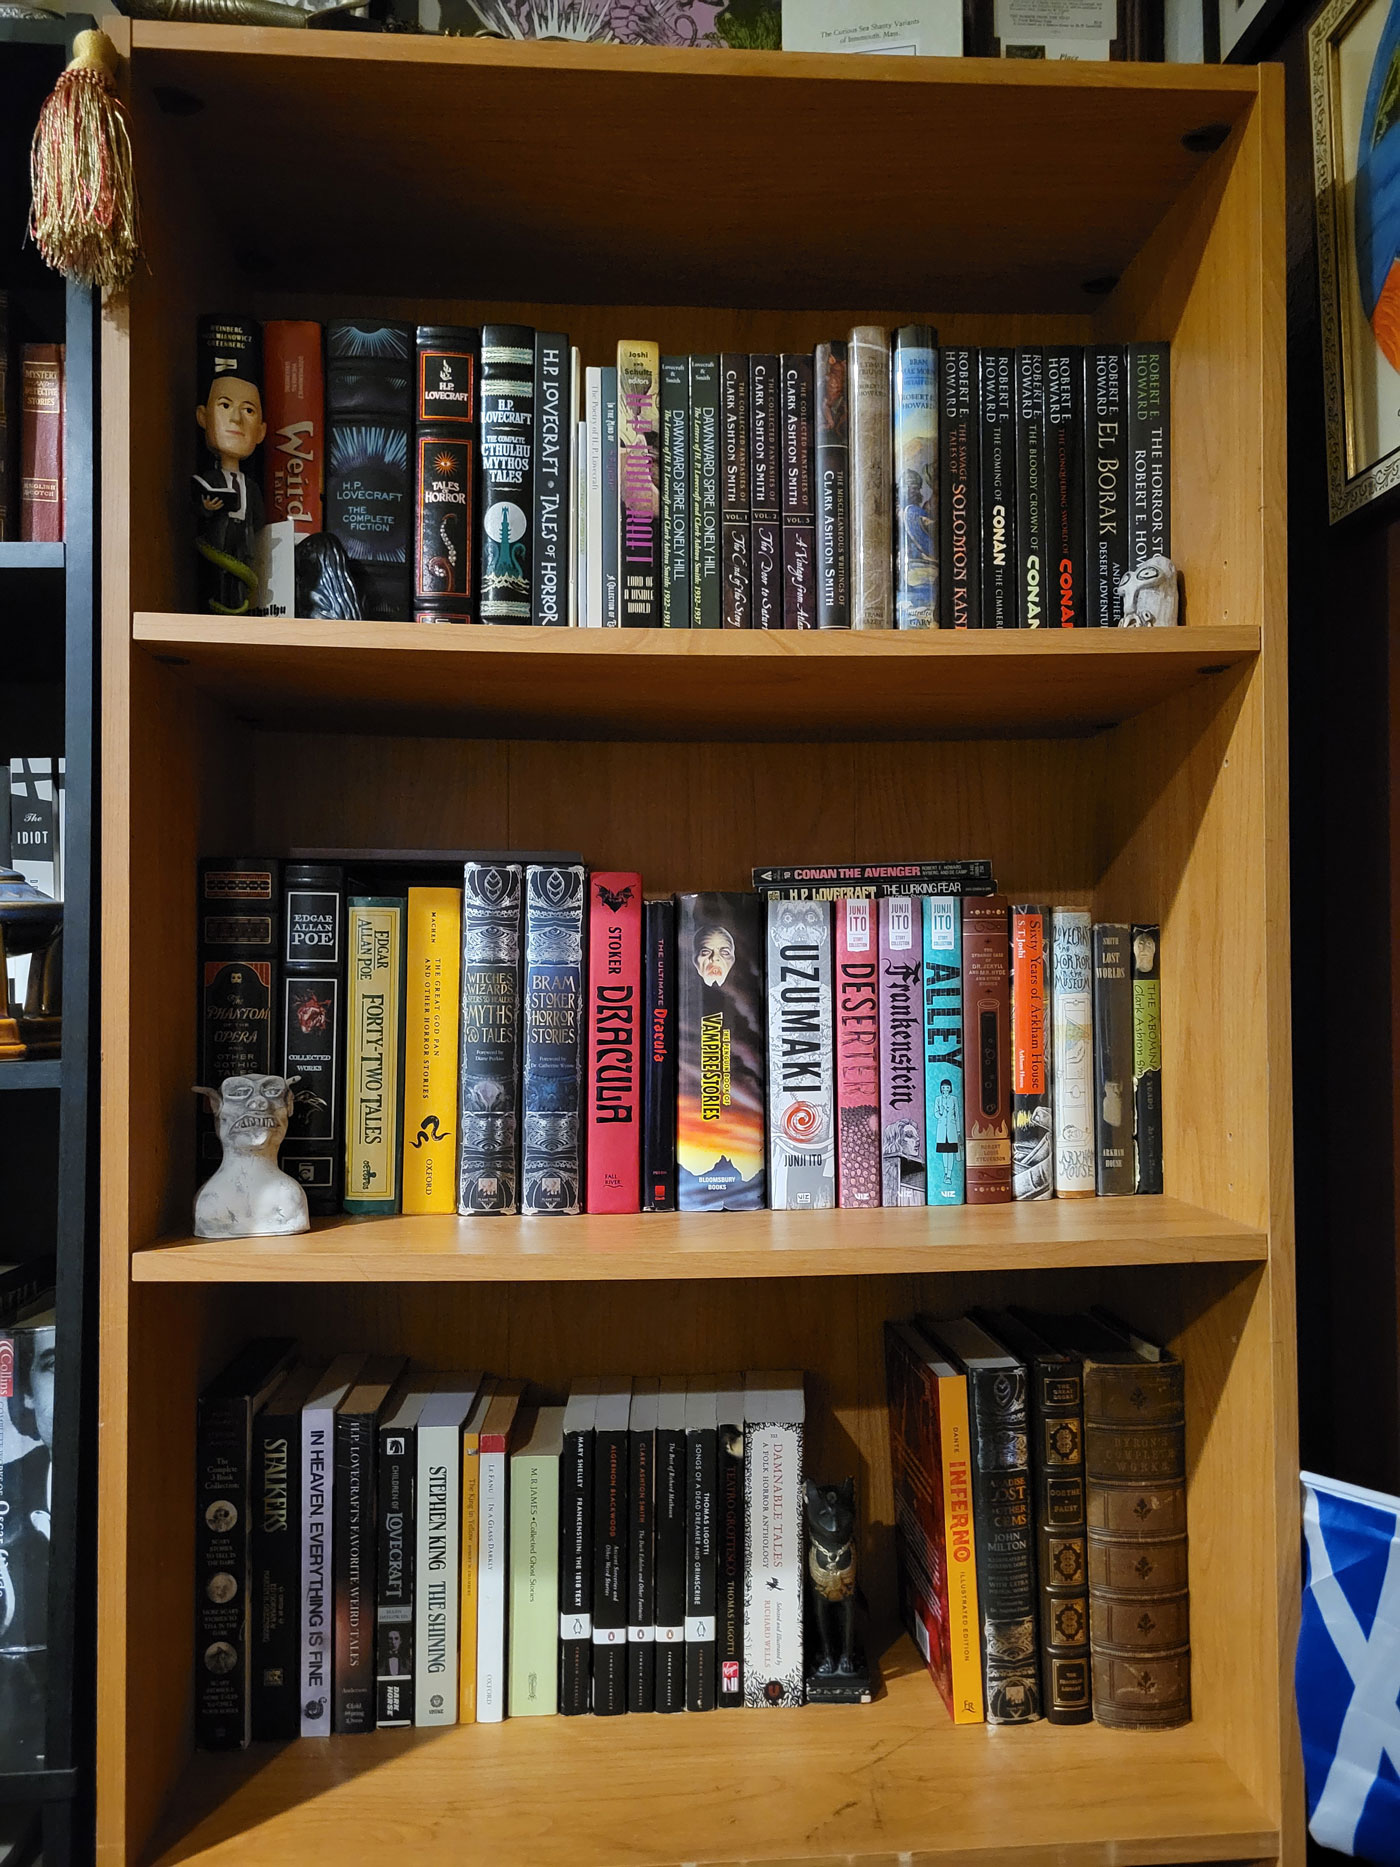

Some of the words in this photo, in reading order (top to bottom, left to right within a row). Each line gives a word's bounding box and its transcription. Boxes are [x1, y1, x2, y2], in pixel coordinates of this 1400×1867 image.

[543, 349, 560, 375] H.P.
[628, 351, 649, 359] Joshi
[628, 378, 650, 386] editors
[726, 370, 738, 411] CLARK
[754, 365, 766, 409] CLARK
[786, 369, 799, 410] CLARK
[946, 351, 957, 418] HOWARD
[958, 351, 970, 403] ROBERT
[985, 356, 996, 423] HOWARD
[1048, 357, 1060, 424] HOWARD
[1060, 357, 1071, 409] ROBERT
[1136, 354, 1148, 421] HOWARD
[1149, 354, 1160, 405] ROBERT
[27, 397, 55, 406] STORIES
[424, 390, 468, 402] LOVECRAFT
[498, 399, 515, 411] H.P.
[481, 412, 532, 425] LOVECRAFT
[541, 380, 560, 475] LOVECRAFT
[726, 413, 738, 460] ASHTON
[754, 411, 767, 459] ASHTON
[481, 445, 530, 458] CTHULHU
[673, 410, 685, 480] DAWNWARD
[703, 407, 715, 477] DAWNWARD
[787, 415, 799, 462] ASHTON
[1151, 426, 1163, 452] THE
[482, 457, 529, 471] MYTHOS
[489, 470, 522, 483] TALES
[755, 463, 767, 501] SMITH
[993, 447, 1001, 487] COMING
[1029, 448, 1038, 491] BLOODY
[1135, 449, 1147, 509] ROBERT
[337, 490, 403, 501] LOVECRAFT
[424, 491, 466, 505] HORROR
[431, 481, 460, 491] TALES
[663, 474, 671, 503] Lovecraft
[673, 482, 685, 511] SPIRE
[704, 479, 716, 508] SPIRE
[727, 465, 738, 502] SMITH
[788, 468, 799, 505] SMITH
[823, 470, 835, 511] CLARK
[1097, 456, 1120, 536] BORAK
[1151, 456, 1163, 529] HORROR
[342, 514, 395, 523] COMPLETE
[350, 523, 390, 532] FICTION
[541, 493, 560, 541] TALES
[1030, 493, 1039, 534] CROWN
[1136, 514, 1147, 526] E.
[673, 514, 685, 557] LONELY
[704, 511, 716, 553] LONELY
[824, 515, 836, 566] ASHTON
[952, 483, 968, 581] SOLOMON
[993, 505, 1007, 566] CONAN
[547, 544, 556, 559] OF
[673, 558, 685, 581] HILL
[704, 555, 716, 577] HILL
[1099, 541, 1108, 578] DESERT
[540, 562, 558, 626] HORROR
[824, 569, 835, 606] SMITH
[17, 831, 49, 845] IDIOT
[794, 868, 838, 879] CONAN
[838, 868, 863, 879] THE
[864, 866, 921, 878] AVENGER
[882, 884, 900, 895] THE
[937, 882, 962, 893] FEAR
[293, 914, 334, 923] EDGAR
[293, 923, 333, 932] ALLAN
[849, 904, 867, 915] JUNJI
[849, 916, 867, 932] ITO
[891, 904, 909, 915] JUNJI
[891, 915, 909, 930] ITO
[933, 904, 951, 915] JUNJI
[933, 915, 951, 930] ITO
[292, 931, 335, 946] POE
[357, 918, 374, 956] ALLAN
[373, 929, 390, 969] EDGAR
[608, 926, 623, 975] STOKER
[1026, 920, 1043, 951] Sixty
[357, 956, 373, 981] POE
[1030, 956, 1042, 985] Years
[1102, 952, 1120, 964] LOST
[531, 993, 576, 1009] STOKER
[532, 975, 576, 992] BRAM
[1030, 988, 1043, 1001] of
[207, 1004, 270, 1021] PHANTOM
[468, 1005, 513, 1027] MYTHS
[531, 1010, 575, 1027] HORROR
[780, 944, 822, 1092] UZUMAKI
[841, 963, 878, 1095] DESERTER
[926, 961, 963, 1069] ALLEY
[1031, 1004, 1043, 1050] Arkham
[213, 1029, 258, 1044] OPERA
[360, 992, 385, 1092] FORTY-TWO
[481, 1028, 513, 1043] TALES
[531, 1029, 576, 1045] STORIES
[653, 1008, 669, 1063] Dracula
[881, 957, 922, 1111] Frankenstein
[596, 985, 634, 1124] DRACULA
[1030, 1053, 1044, 1089] House
[701, 1072, 722, 1122] STORIES
[360, 1093, 383, 1145] TALES
[426, 1158, 434, 1196] OXFORD
[784, 1156, 806, 1167] JUNJI
[806, 1154, 823, 1166] ITO
[0, 1353, 12, 1395] Collins
[309, 1430, 325, 1446] IN
[694, 1443, 703, 1468] SONGS
[762, 1450, 770, 1472] FOLK
[263, 1438, 288, 1533] STALKERS
[391, 1465, 401, 1495] CHILDREN
[428, 1465, 447, 1531] STEPHEN
[762, 1475, 770, 1512] HORROR
[772, 1443, 784, 1521] DAMNABLE
[703, 1493, 711, 1523] THOMAS
[949, 1460, 972, 1563] INFERNO
[1054, 1504, 1078, 1513] FAUST
[385, 1512, 404, 1598] LOVECRAFT
[428, 1534, 447, 1571] KING
[702, 1525, 710, 1556] LIGOTTI
[761, 1514, 770, 1569] ANTHOLOGY
[772, 1523, 784, 1568] TALES
[987, 1540, 1027, 1551] MILTON
[994, 1532, 1020, 1542] JOHN
[308, 1522, 325, 1628] EVERYTHING
[428, 1580, 447, 1611] THE
[727, 1580, 736, 1618] THOMAS
[308, 1631, 324, 1647] IS
[427, 1613, 447, 1675] SHINING
[726, 1621, 735, 1656] LIGOTTI
[308, 1650, 323, 1688] FINE
[386, 1685, 394, 1717] HORSE
[393, 1685, 401, 1712] DARK
